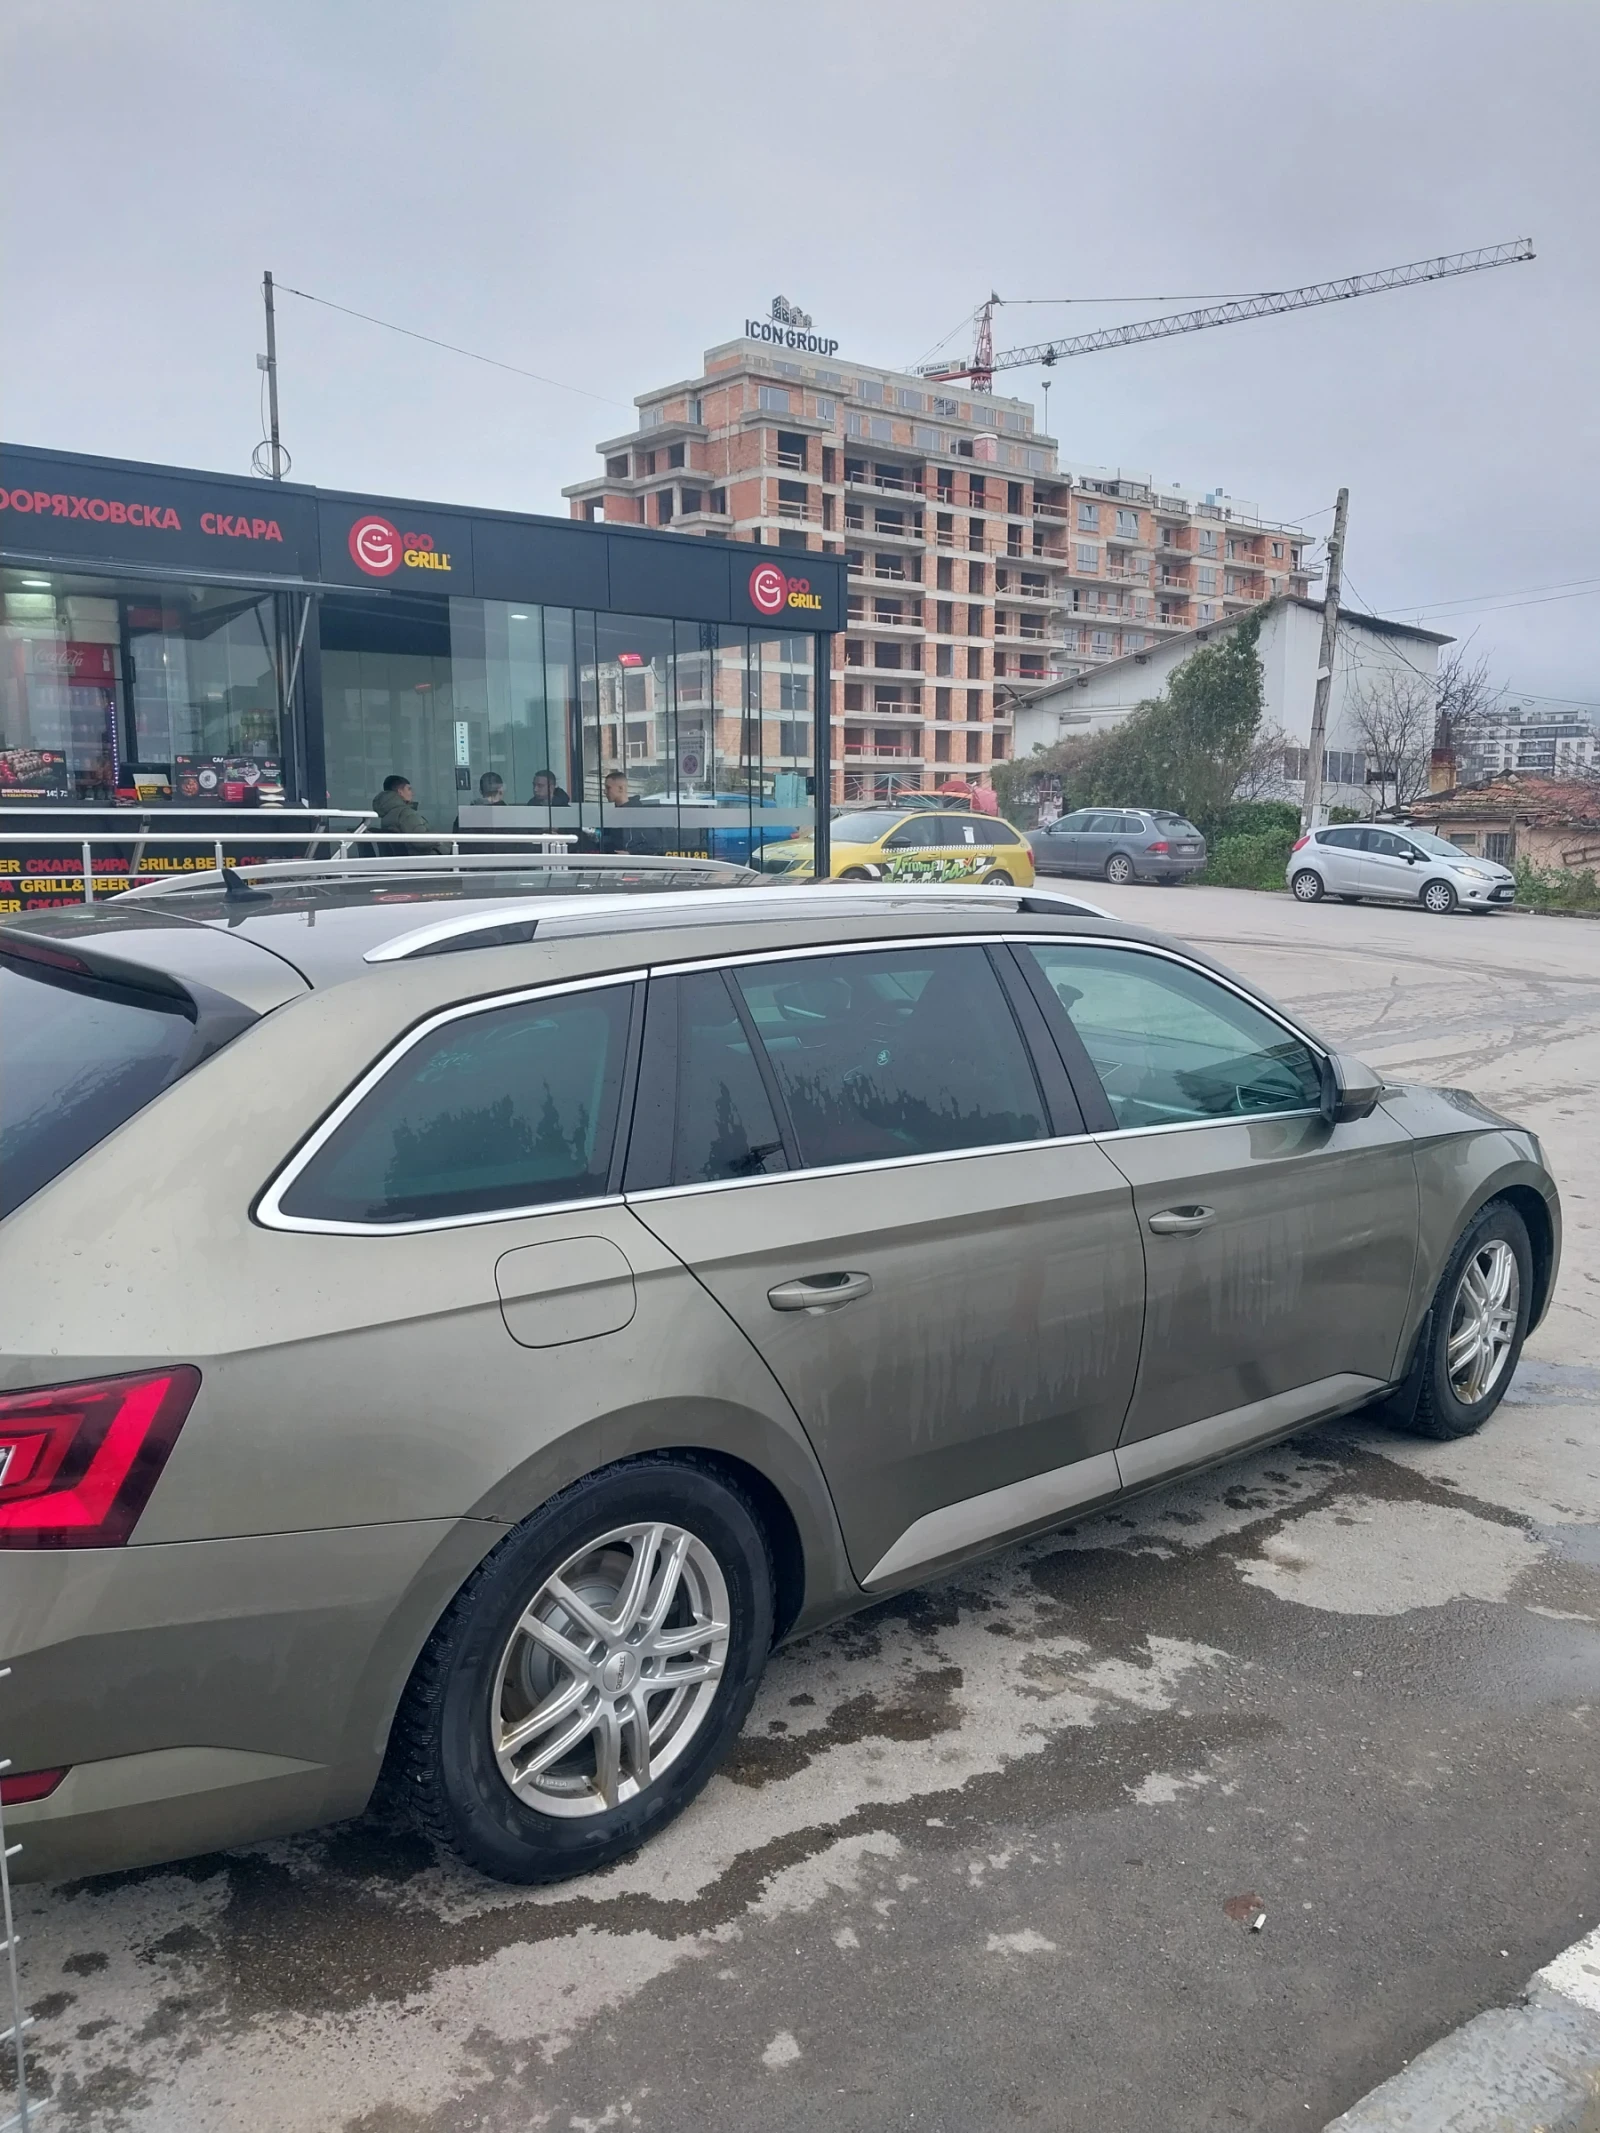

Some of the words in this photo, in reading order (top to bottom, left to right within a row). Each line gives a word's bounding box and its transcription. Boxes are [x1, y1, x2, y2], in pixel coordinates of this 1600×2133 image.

[200, 512, 283, 542] СКАРА
[403, 532, 434, 551] GO
[404, 549, 451, 571] GRILL
[788, 577, 810, 593] GO
[788, 592, 822, 610] GRILL
